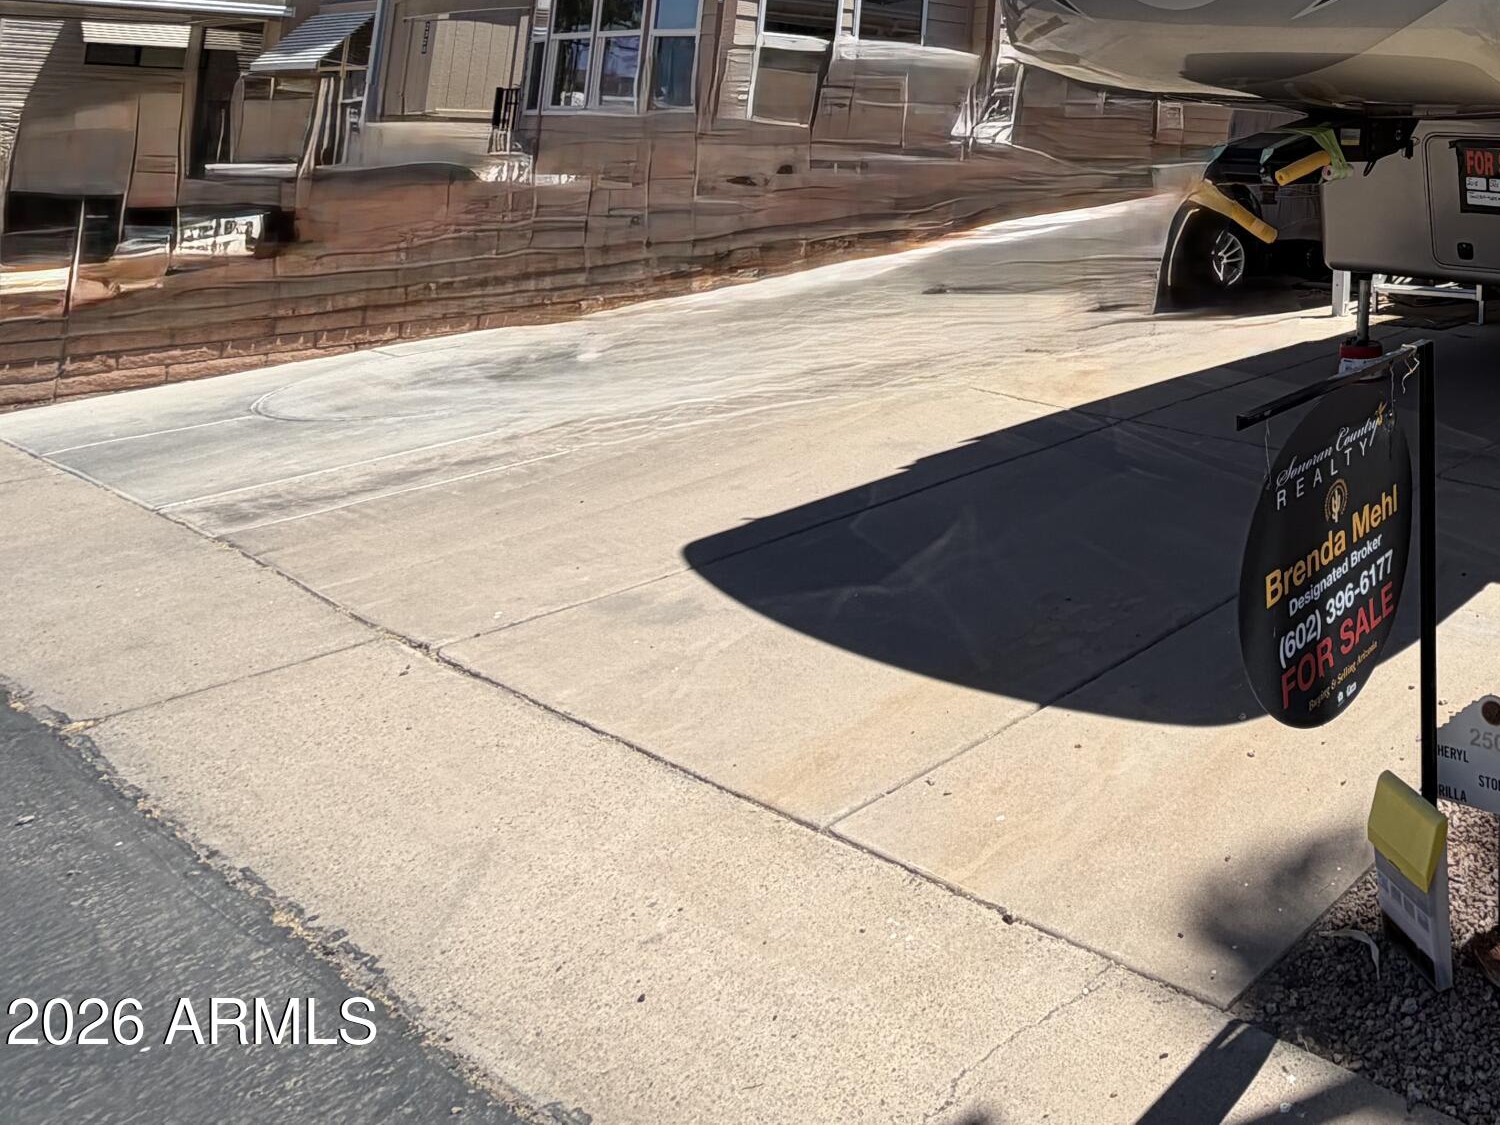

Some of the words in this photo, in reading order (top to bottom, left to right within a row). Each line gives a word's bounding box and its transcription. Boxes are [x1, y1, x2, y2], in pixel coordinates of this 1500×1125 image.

[1465, 149, 1494, 176] FOR
[1276, 447, 1333, 490] Sonoran
[1336, 417, 1378, 447] Country
[1277, 437, 1368, 511] REALTY
[1265, 530, 1346, 609] Brenda
[1352, 483, 1398, 544] Mehl
[1289, 557, 1349, 617] Designated
[1350, 534, 1383, 568] Broker
[1279, 609, 1322, 669] (602)
[1326, 548, 1394, 624] 396-6177
[1281, 637, 1334, 710] FOR
[1340, 580, 1394, 655] SALE
[1337, 661, 1357, 684] Selling
[1437, 744, 1469, 764] HERYL
[1438, 783, 1468, 803] RILLA
